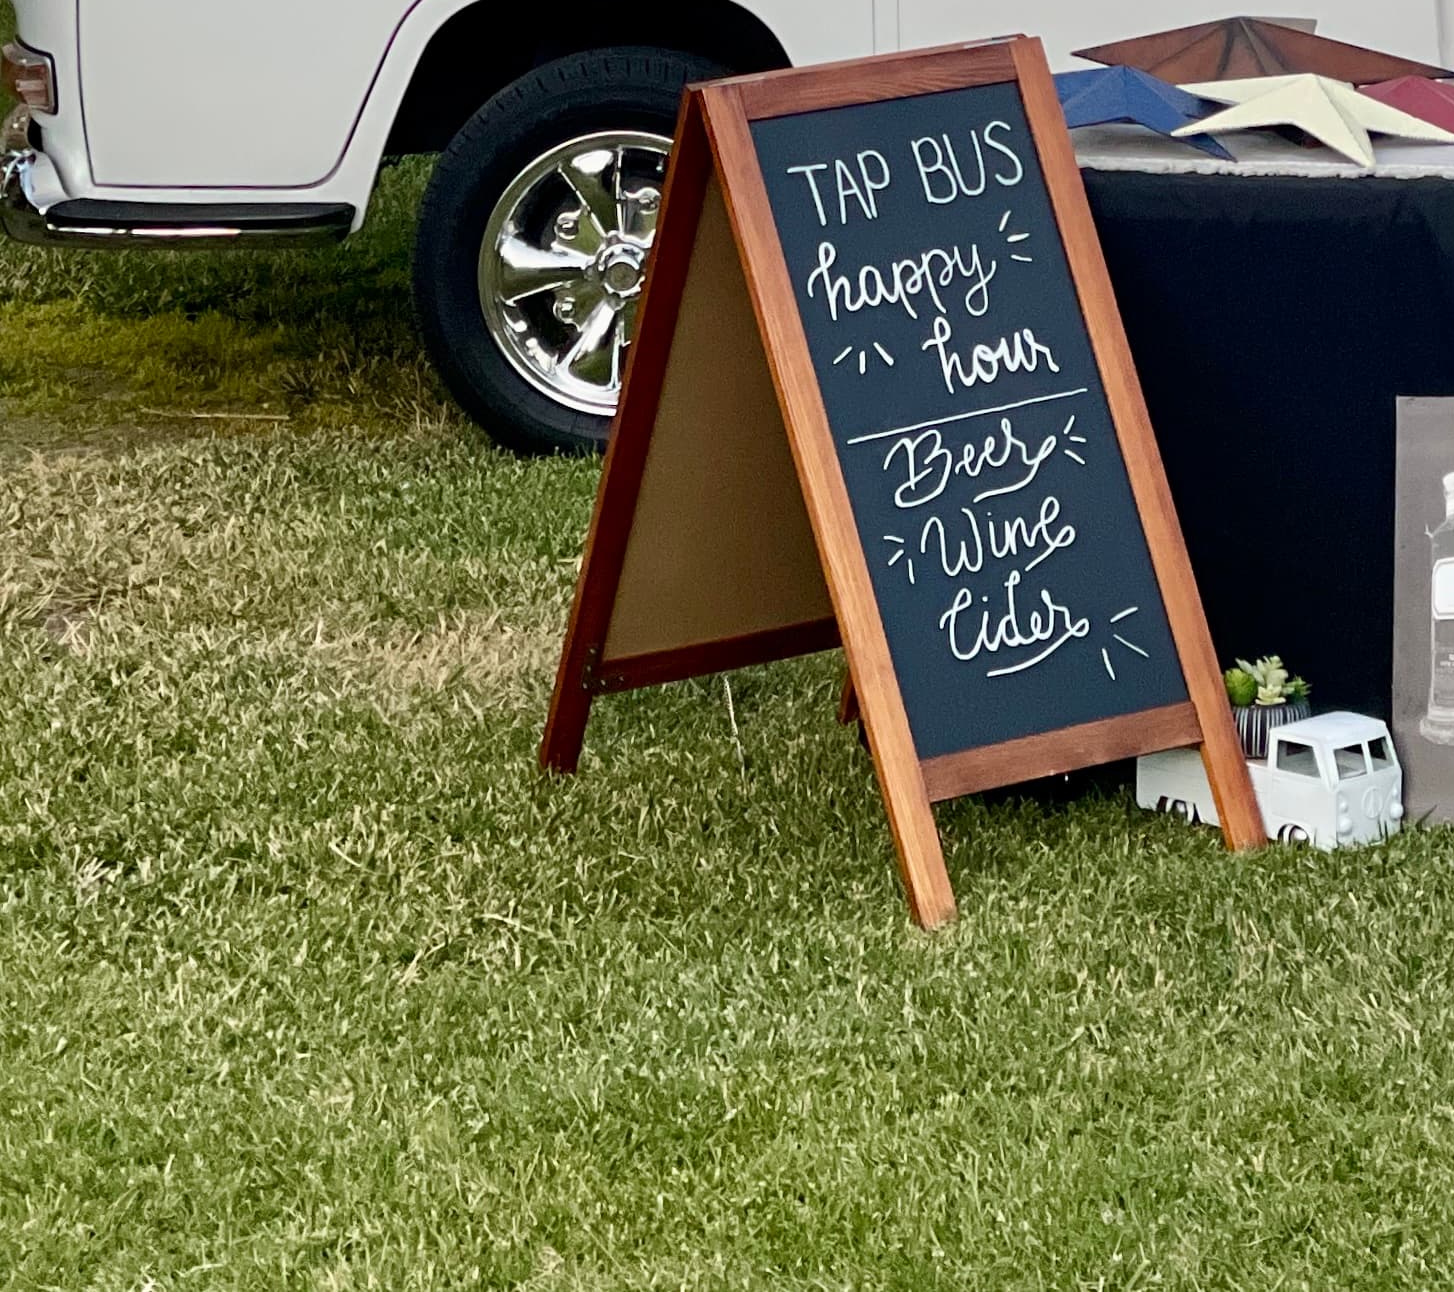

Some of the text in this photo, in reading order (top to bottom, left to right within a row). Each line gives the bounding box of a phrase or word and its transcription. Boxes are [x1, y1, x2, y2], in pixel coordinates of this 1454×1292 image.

[786, 120, 1024, 226] TAP BUS
[807, 241, 998, 321] happy
[922, 315, 1060, 394] hour
[883, 418, 1058, 508] Beer
[920, 496, 1076, 577] Wine
[939, 567, 1090, 676] Cider
